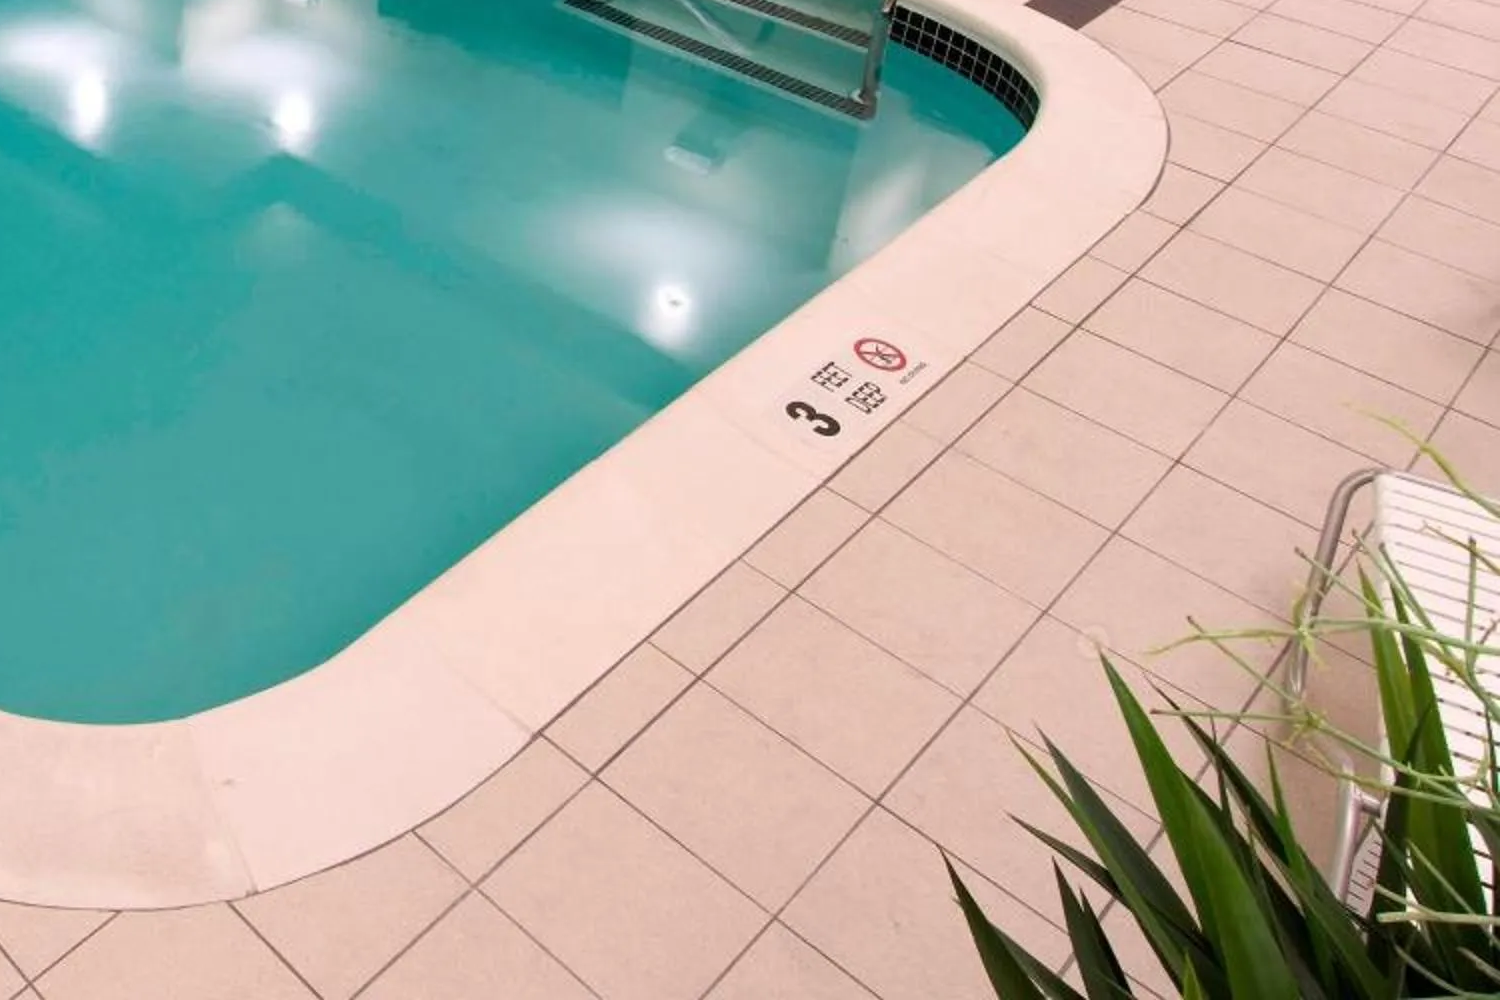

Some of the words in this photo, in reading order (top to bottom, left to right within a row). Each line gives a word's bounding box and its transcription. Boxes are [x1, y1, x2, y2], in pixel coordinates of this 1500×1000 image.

[810, 361, 852, 393] FEET
[844, 381, 887, 414] DEEP
[785, 401, 841, 437] 3
